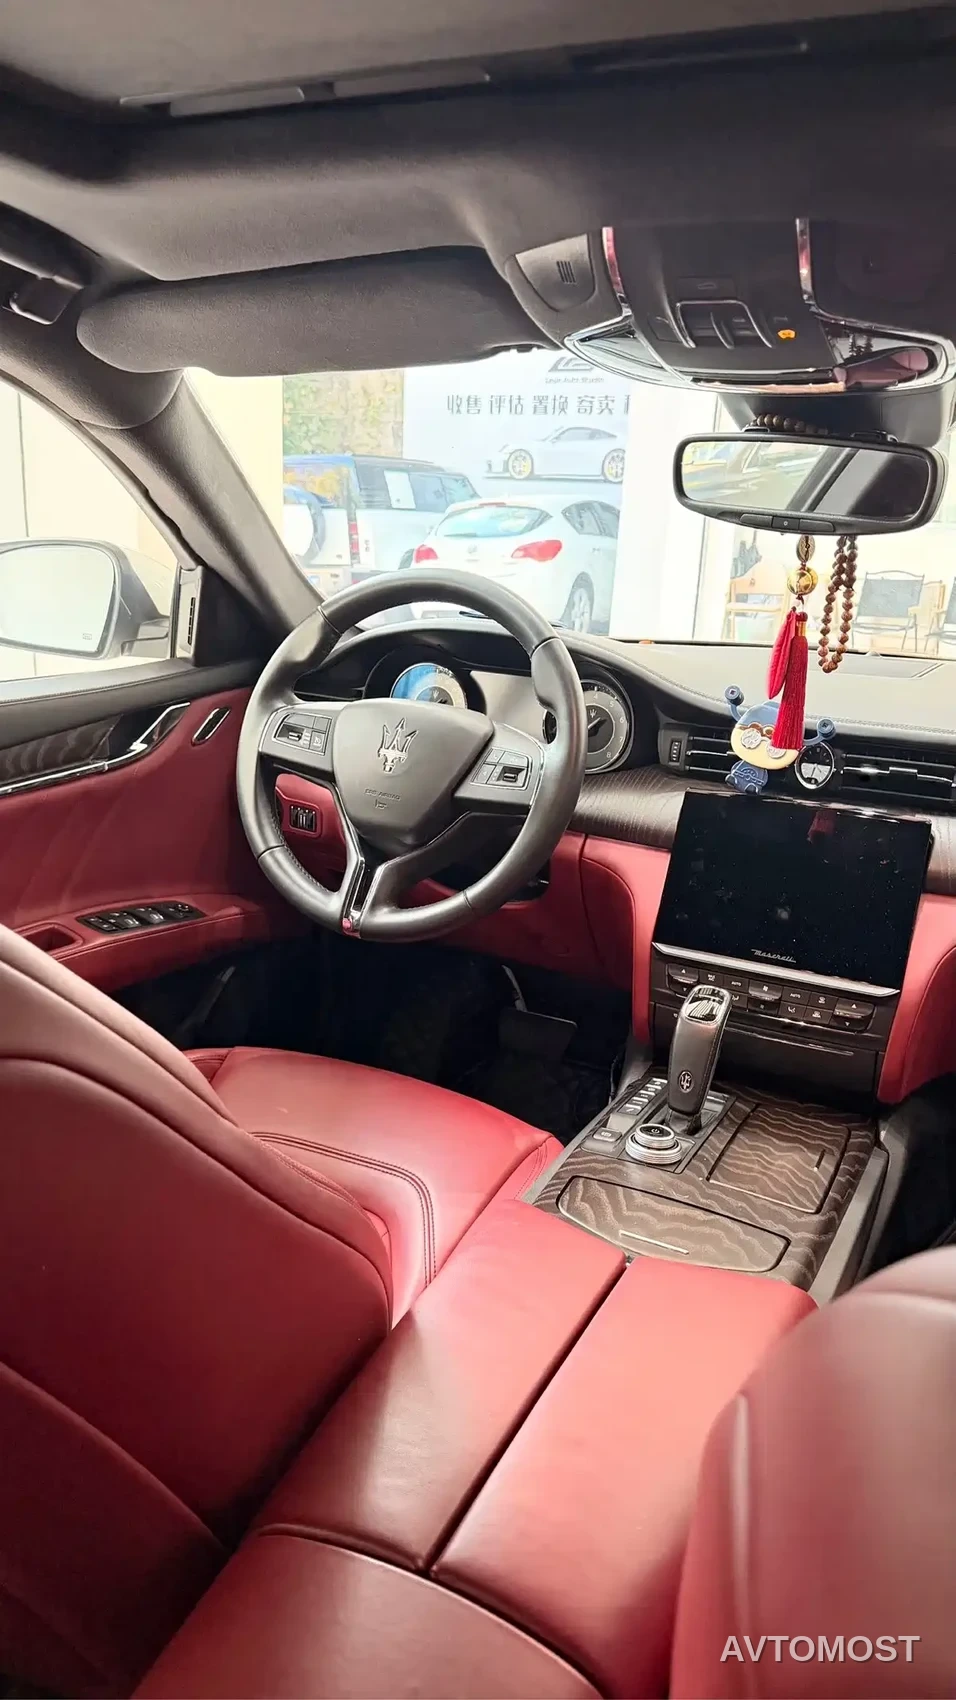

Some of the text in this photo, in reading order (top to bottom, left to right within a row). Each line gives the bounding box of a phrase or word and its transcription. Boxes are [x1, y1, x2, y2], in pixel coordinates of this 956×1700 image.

[447, 394, 482, 415] 收售
[489, 394, 524, 415] 评估
[532, 394, 569, 416] 置换
[576, 394, 616, 416] 寄卖
